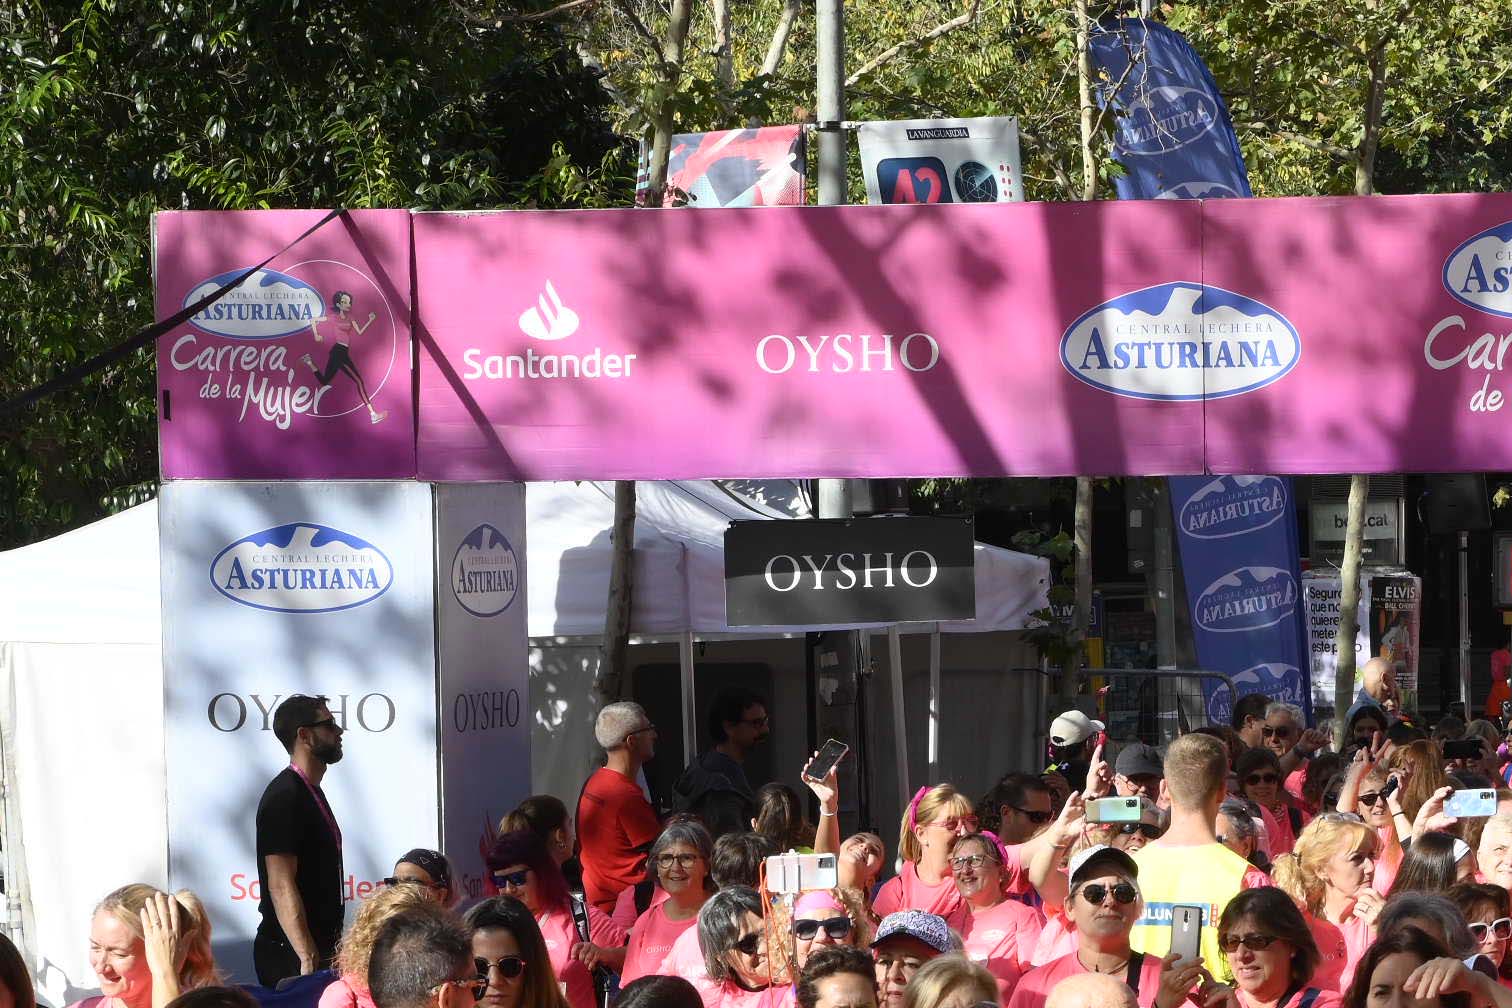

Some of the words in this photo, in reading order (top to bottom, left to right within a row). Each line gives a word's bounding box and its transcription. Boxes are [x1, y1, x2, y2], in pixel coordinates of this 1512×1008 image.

[1115, 322, 1191, 335] CENTRAL
[1200, 322, 1273, 334] LECHERA
[170, 334, 288, 371] Carrera
[463, 348, 637, 379] Santander
[755, 333, 939, 374] OYSHO
[1080, 327, 1281, 370] ASTURIANA
[199, 373, 222, 399] de
[226, 373, 241, 399] la
[239, 368, 332, 430] Mujer
[1469, 374, 1504, 413] de
[225, 556, 380, 591] ASTURIANA
[252, 553, 309, 564] CENTRAL
[315, 553, 374, 564] LECHERA
[764, 550, 938, 592] OYSHO
[457, 561, 517, 595] ASTURIANA
[1385, 586, 1416, 598] ELVIS
[1311, 602, 1327, 615] que
[207, 692, 396, 732] OYHO
[454, 689, 520, 733] OYSHO
